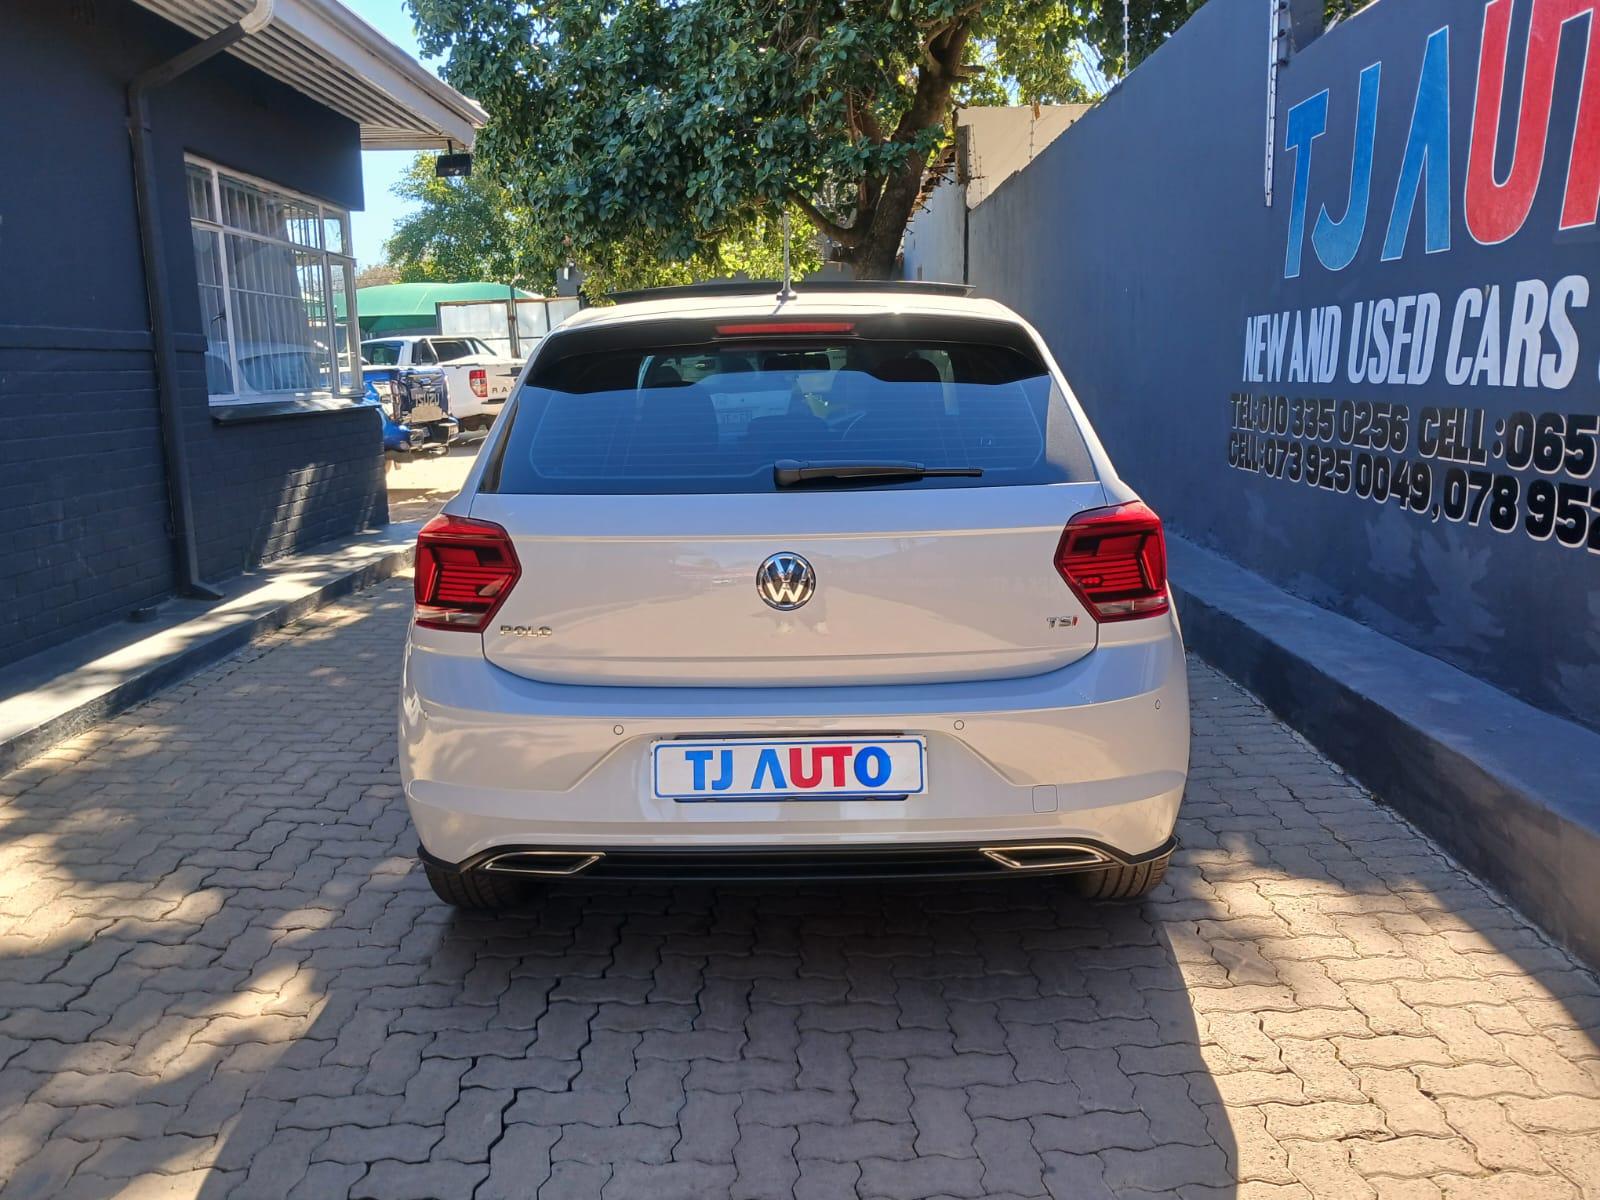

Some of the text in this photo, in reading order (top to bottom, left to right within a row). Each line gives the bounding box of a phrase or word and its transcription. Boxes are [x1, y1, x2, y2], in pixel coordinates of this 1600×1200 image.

[1242, 274, 1590, 390] NEW AND USED CARS
[1292, 398, 1336, 443] 335
[1338, 400, 1410, 454] 0256
[1306, 443, 1353, 494] 925
[500, 625, 553, 638] POLO
[685, 746, 892, 791] TJ AUTO
